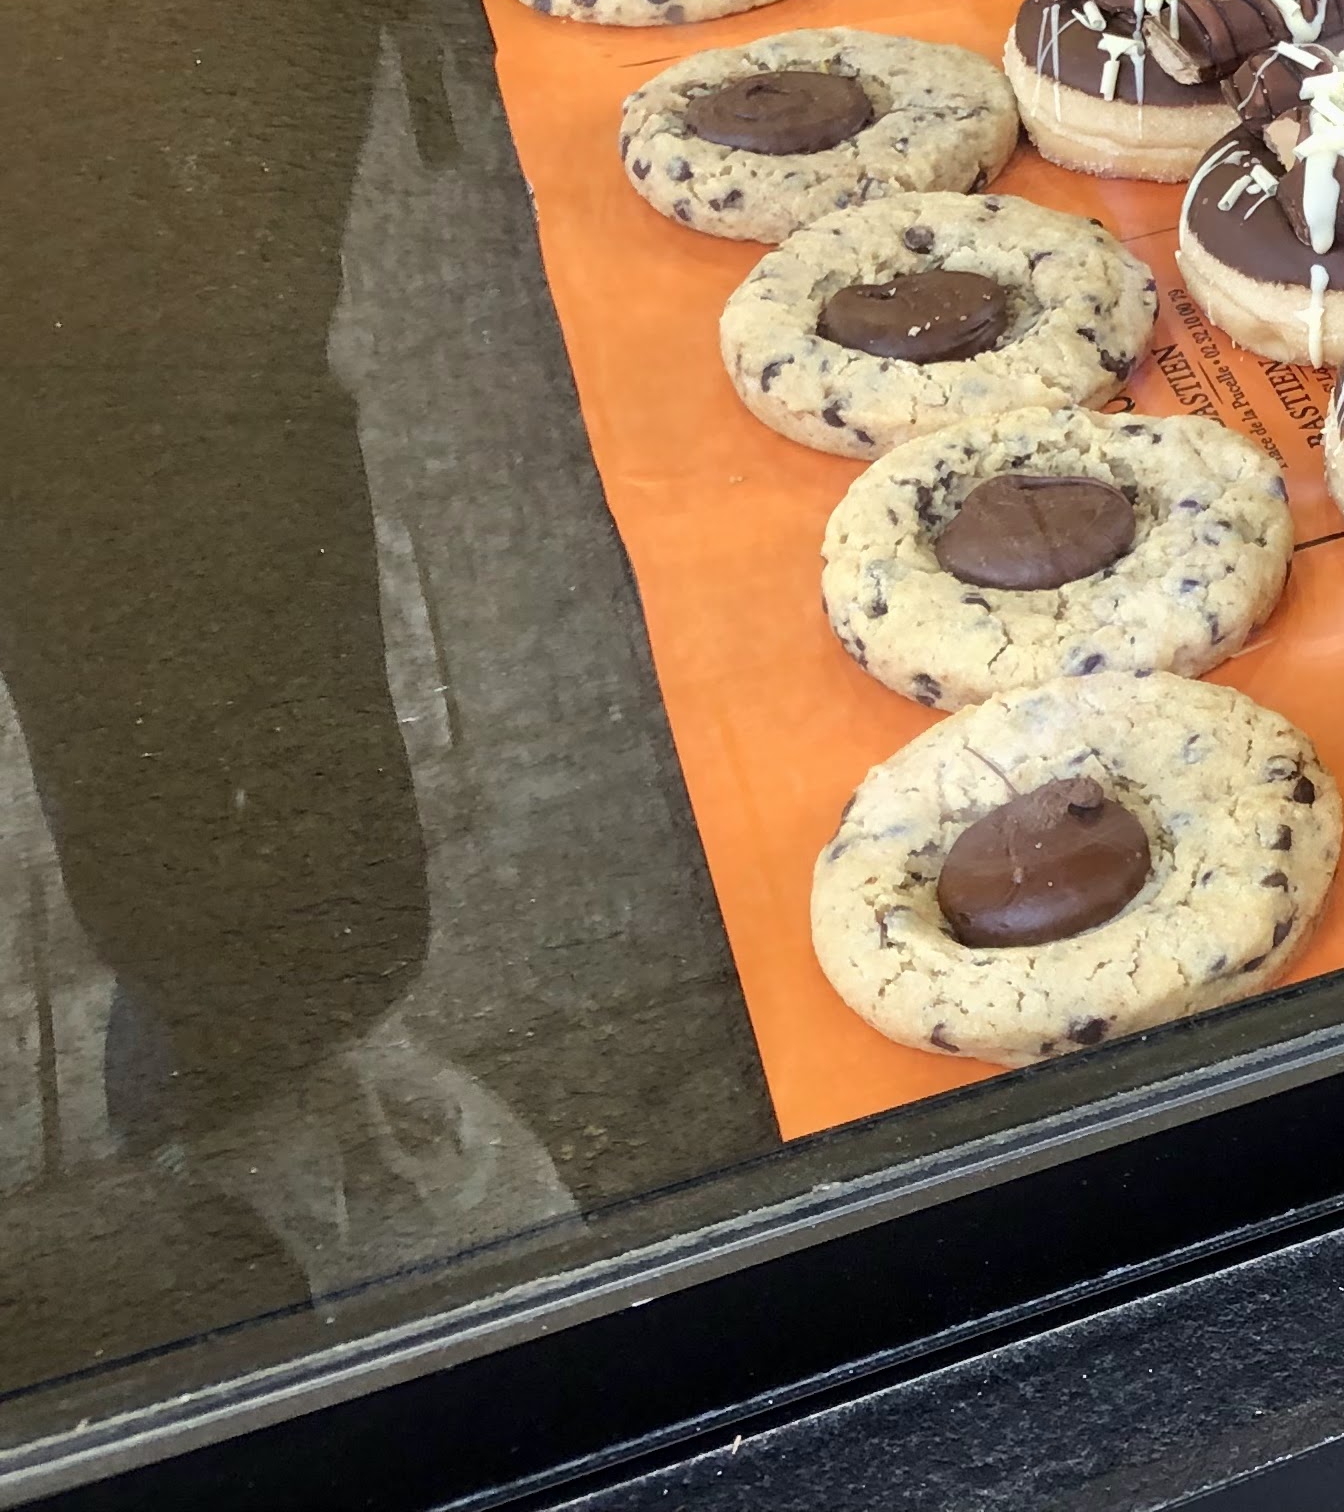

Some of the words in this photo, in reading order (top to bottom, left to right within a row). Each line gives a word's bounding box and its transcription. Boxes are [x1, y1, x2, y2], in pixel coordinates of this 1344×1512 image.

[1167, 288, 1184, 302] 79
[1176, 302, 1196, 317] 00
[1183, 315, 1203, 330] 10
[1200, 343, 1221, 359] 02
[1216, 365, 1250, 410] Pucelle
[1242, 408, 1259, 422] la
[1249, 421, 1267, 436] de
